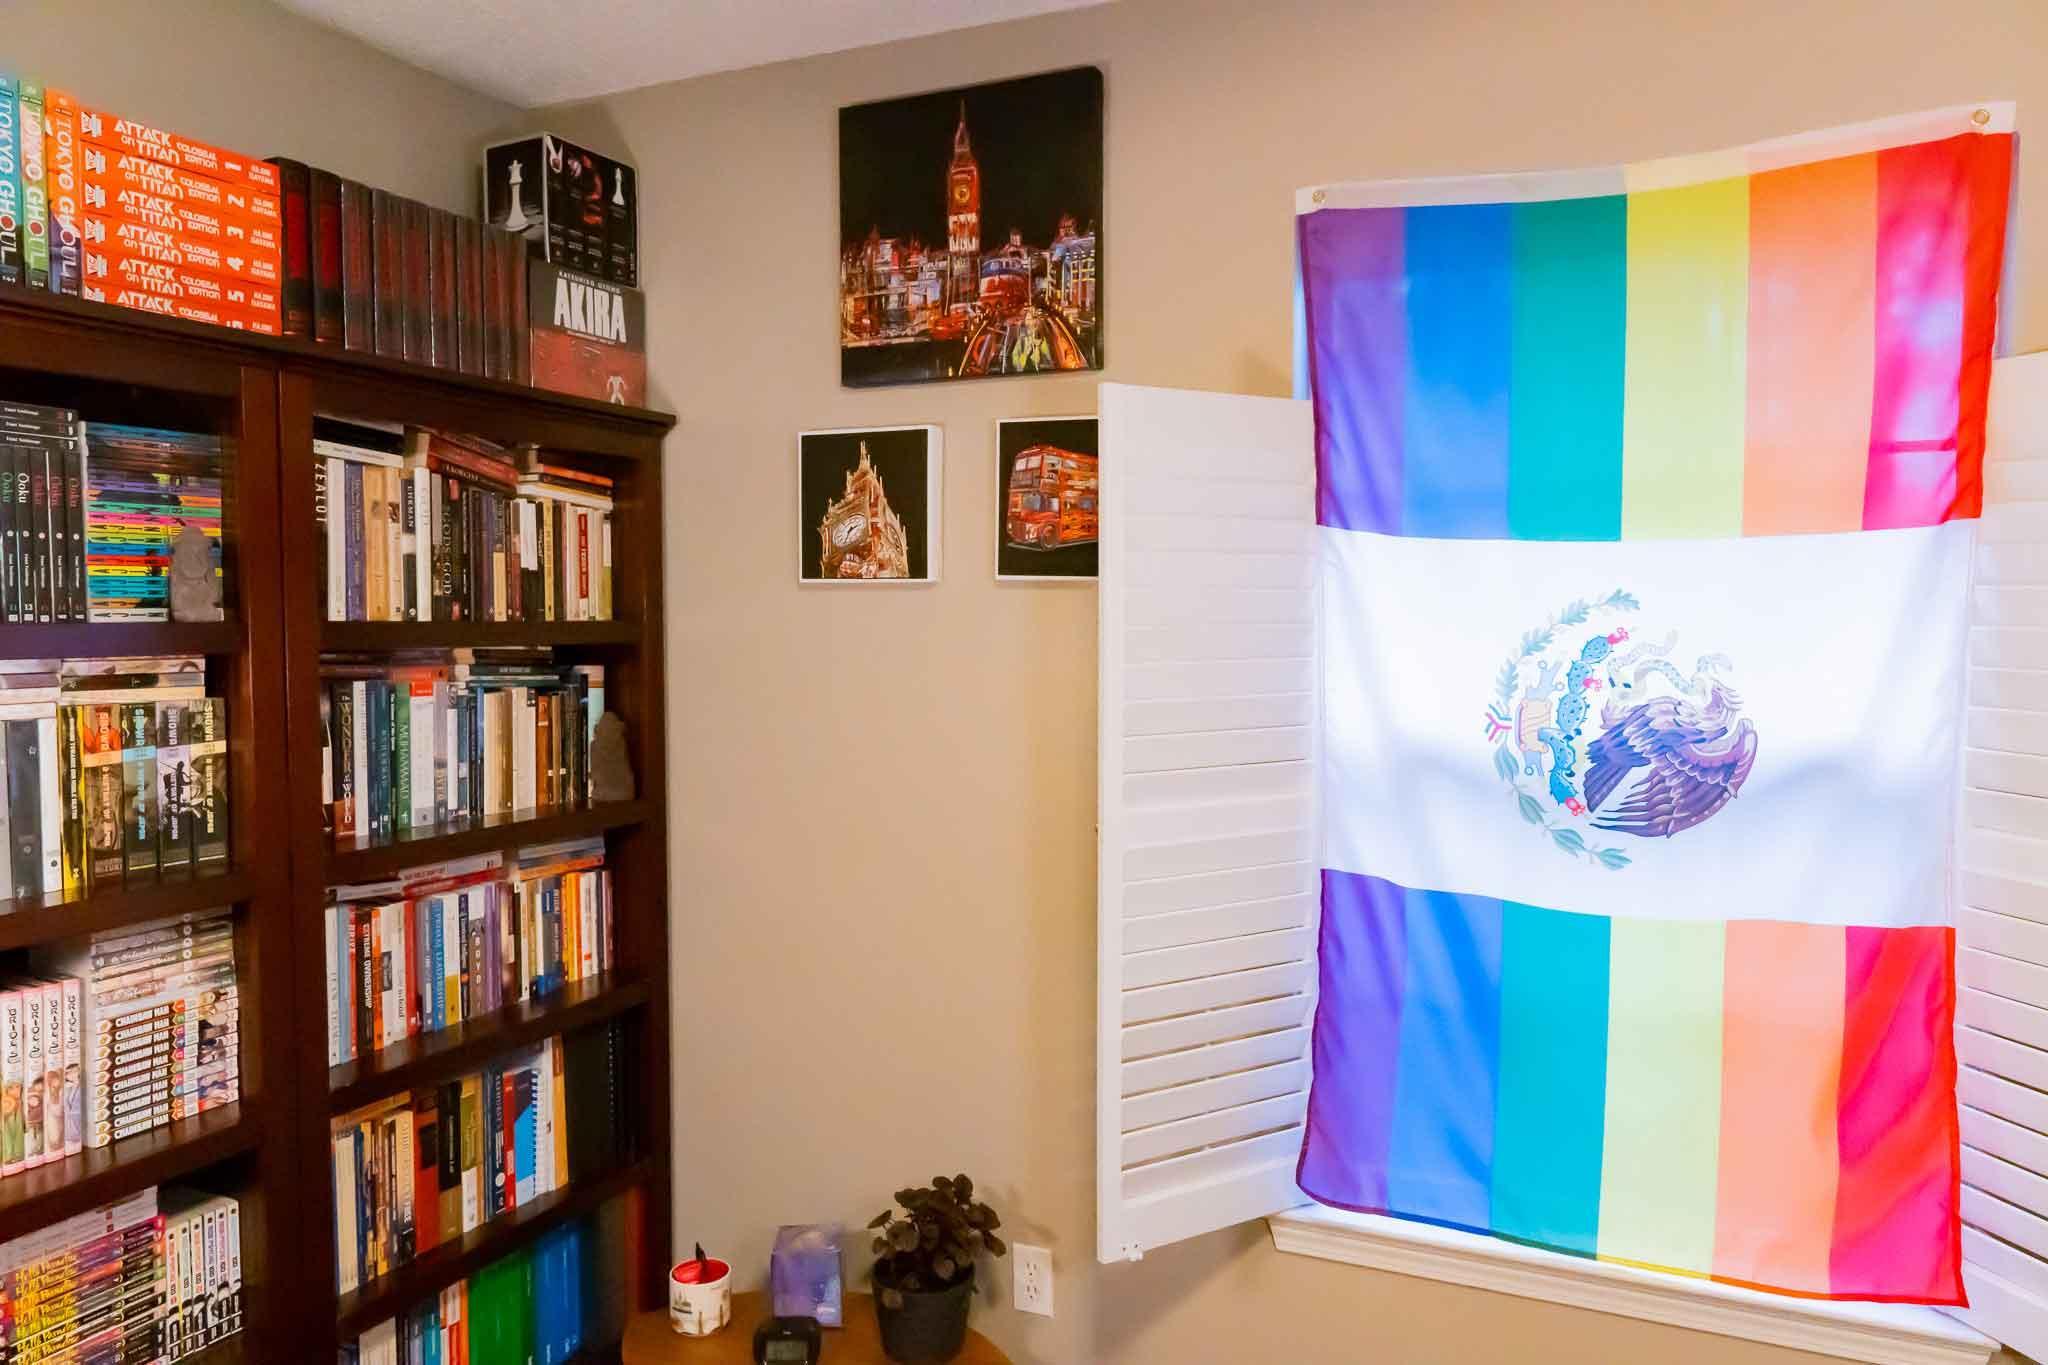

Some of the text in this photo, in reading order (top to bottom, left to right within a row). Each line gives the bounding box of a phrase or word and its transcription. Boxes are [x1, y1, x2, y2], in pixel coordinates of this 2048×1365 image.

[0, 99, 14, 175] TOKYO
[114, 119, 172, 147] ATTACK
[136, 140, 180, 164] TITAN
[176, 142, 216, 160] COLOSSAL
[184, 154, 218, 170] EDITION
[118, 156, 174, 182] ATTACK
[224, 161, 242, 171] 1
[24, 107, 45, 271] TOKYO GHOUL
[140, 175, 184, 201] TITAN
[179, 177, 219, 194] COLOSSAL
[188, 189, 221, 205] EDITION
[56, 119, 78, 278] TOKYO GHOUL
[117, 189, 174, 216] ATTACK
[227, 194, 244, 208] 2
[139, 207, 183, 231] TITAN
[179, 208, 219, 227] COLOSSAL
[187, 221, 220, 236] EDITION
[117, 224, 174, 249] ATTACK
[227, 225, 244, 239] 3
[138, 242, 182, 264] TITAN
[179, 242, 220, 259] COLOSSAL
[187, 254, 220, 269] EDITION
[119, 258, 175, 281] ATTACK
[227, 257, 244, 271] 4
[140, 276, 184, 298] TITAN
[180, 274, 220, 291] COLOSSAL
[188, 286, 221, 301] EDITION
[117, 291, 174, 313] ATTACK
[227, 290, 244, 303] 5
[179, 307, 219, 321] COLOSSAL
[554, 278, 628, 343] AKIRA
[315, 463, 328, 523] ZEALOT
[90, 524, 161, 532] AJIN
[443, 562, 452, 595] GOD
[93, 610, 168, 619] AJIN
[97, 712, 110, 751] SHOWA
[135, 709, 145, 745] SHOWA
[167, 709, 177, 745] SHOWA
[204, 705, 214, 741] SHOWA
[399, 723, 409, 799] MUHAMMAD
[138, 815, 146, 841] JAPAN
[207, 810, 215, 833] JAPAN
[103, 822, 112, 847] JAPAN
[363, 960, 372, 1009] OWNERSHIP
